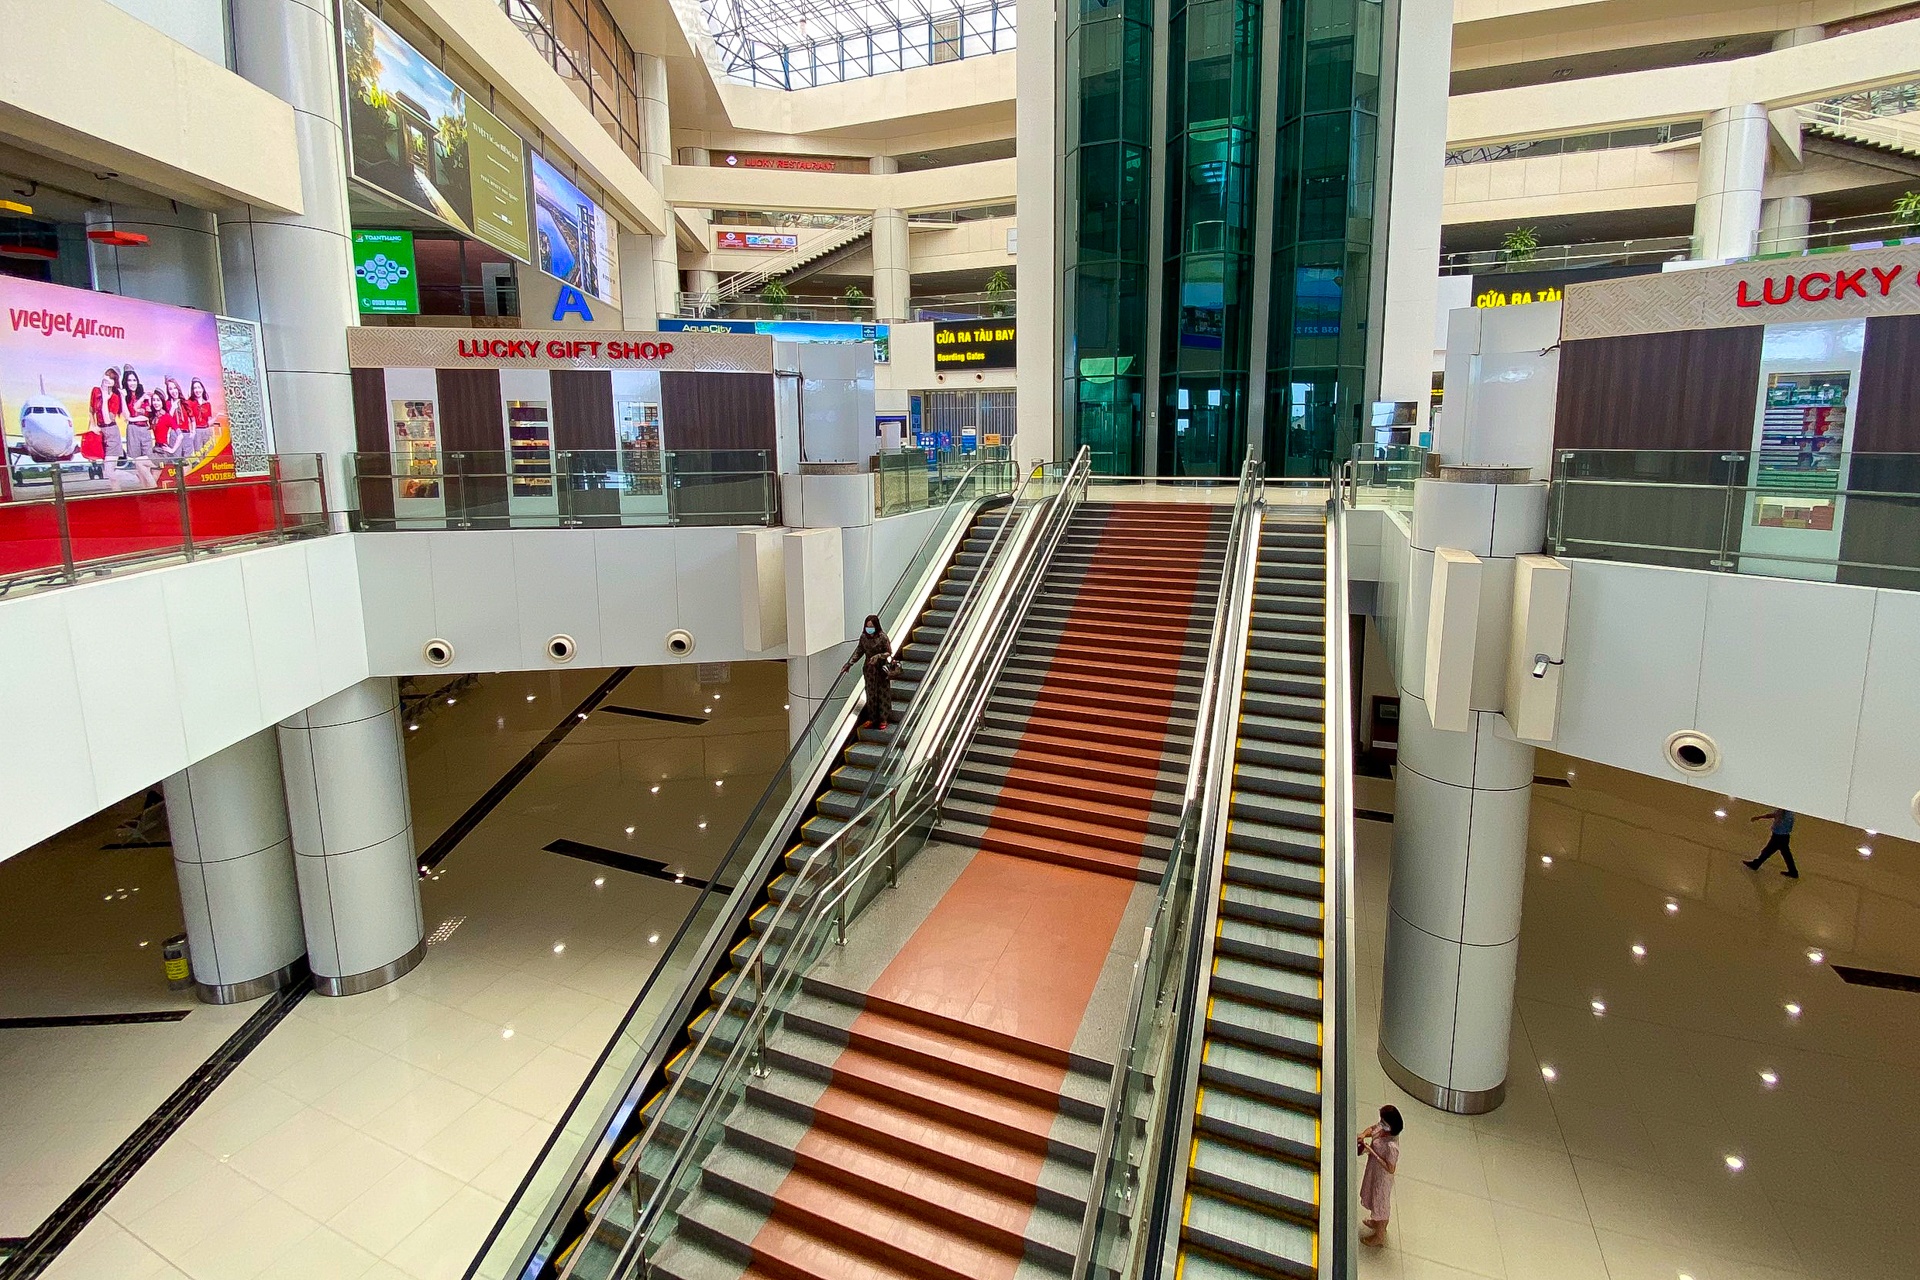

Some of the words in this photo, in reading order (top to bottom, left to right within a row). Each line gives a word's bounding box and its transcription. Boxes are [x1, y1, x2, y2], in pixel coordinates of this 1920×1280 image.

[745, 159, 774, 168] LUCKY
[777, 160, 836, 170] RESTAURANT
[1736, 264, 1902, 308] LUCKY
[553, 284, 594, 321] A
[1477, 289, 1506, 308] CỬA
[1511, 292, 1532, 305] RA
[682, 324, 732, 333] AquaCity
[936, 330, 955, 344] CỬA
[957, 331, 971, 343] RA
[974, 328, 993, 342] TÀU
[995, 329, 1014, 341] BAY
[458, 339, 540, 358] LUCKY
[546, 341, 601, 359] GIFT
[607, 341, 674, 360] SHOP
[937, 353, 965, 362] Boarding
[966, 352, 985, 361] Gates
